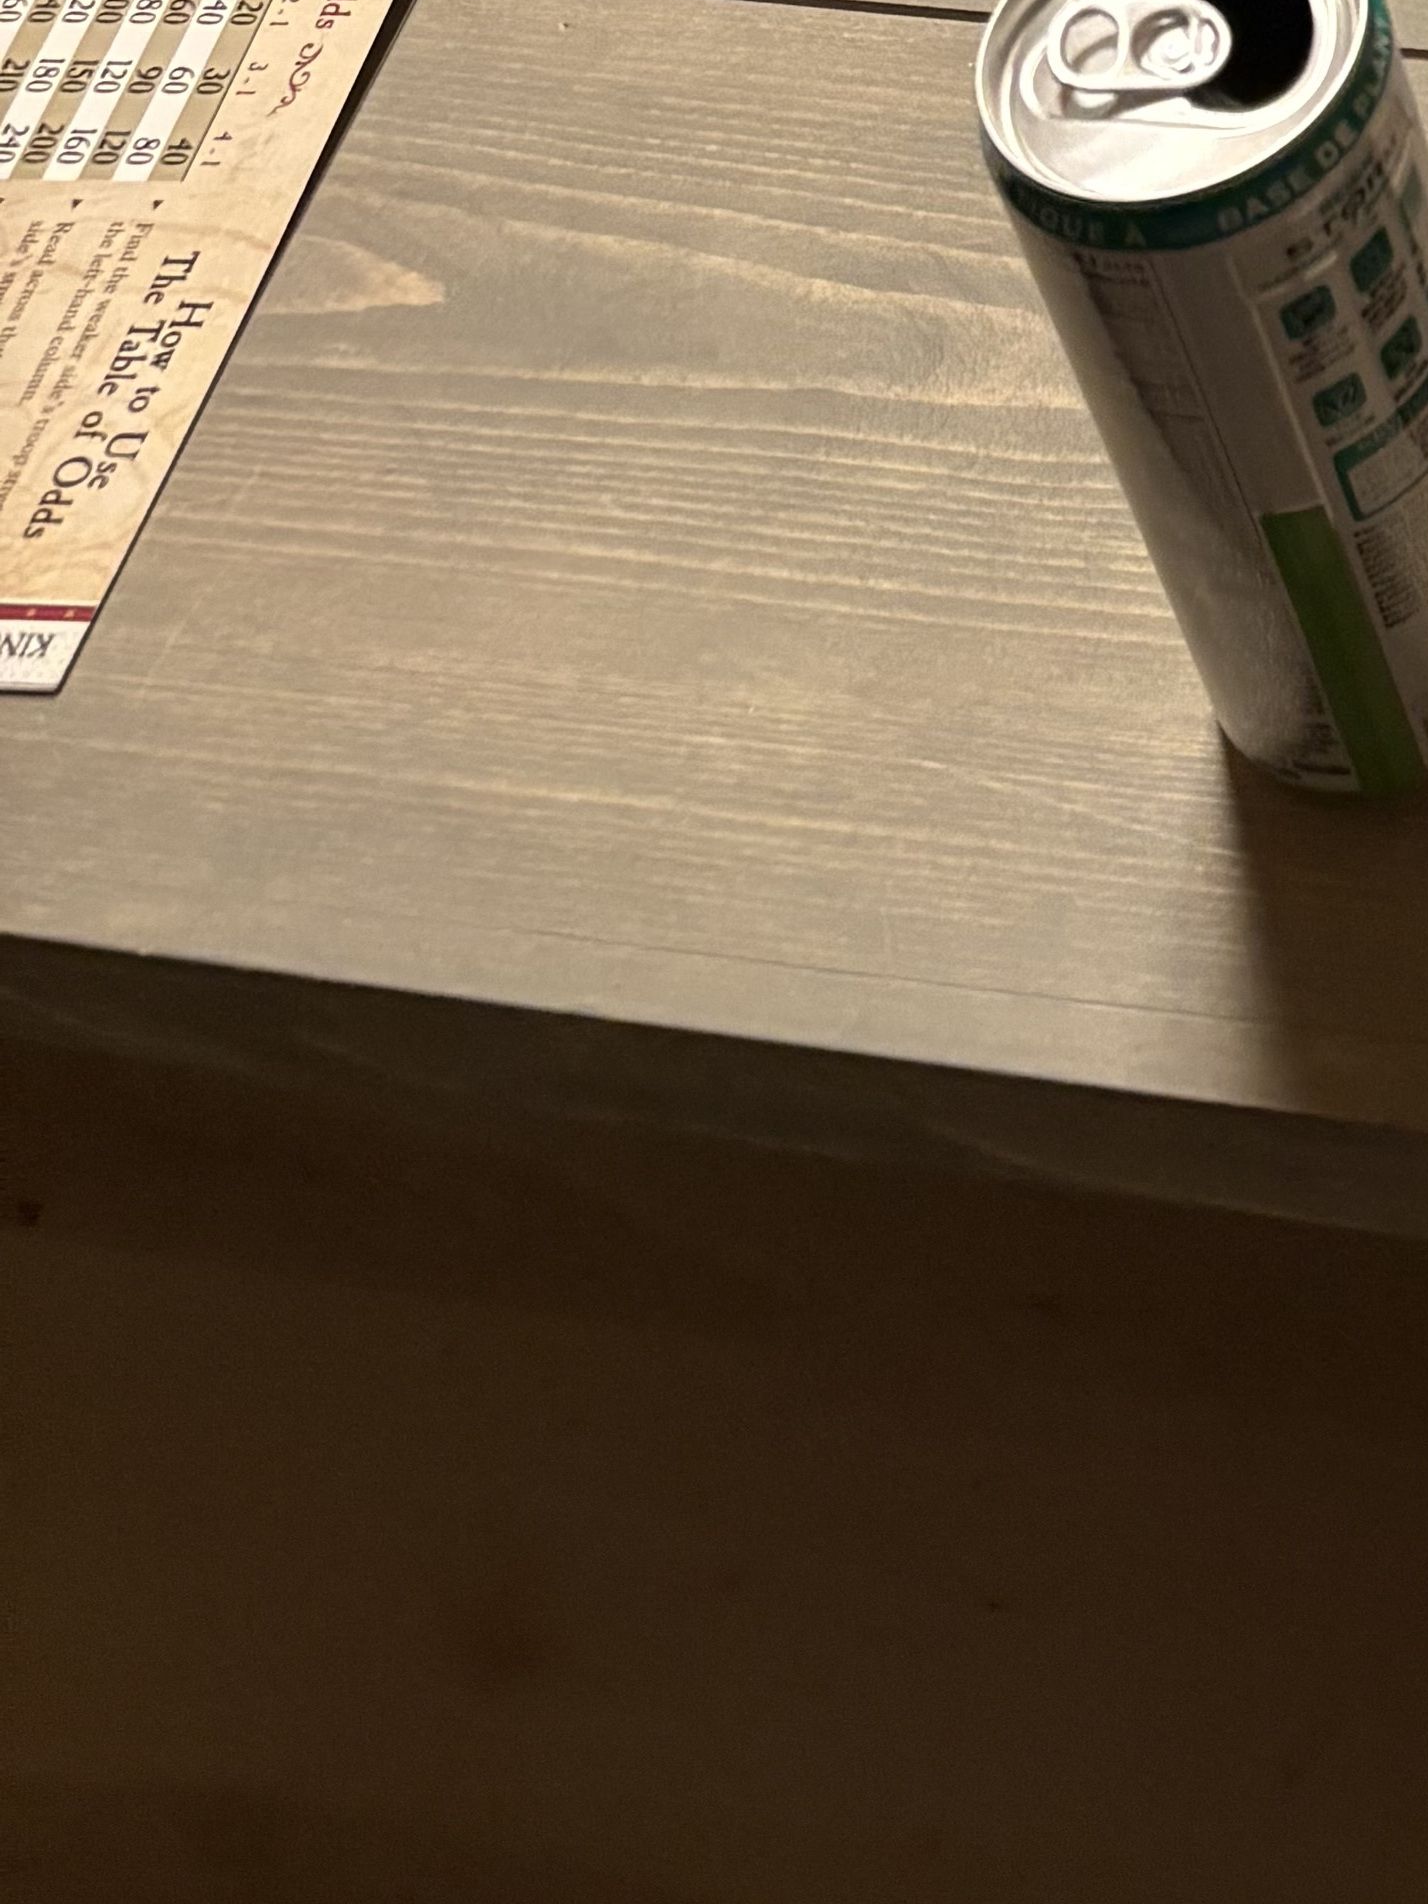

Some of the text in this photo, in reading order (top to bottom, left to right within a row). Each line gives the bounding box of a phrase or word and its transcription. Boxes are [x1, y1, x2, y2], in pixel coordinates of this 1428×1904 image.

[59, 58, 100, 93] 150
[93, 59, 134, 94] 120
[127, 65, 164, 94] 90
[161, 66, 196, 94] 60
[196, 66, 230, 95] 30
[22, 122, 64, 165] 200
[56, 128, 98, 165] 160
[91, 130, 132, 166] 120
[125, 137, 161, 166] 80
[161, 137, 195, 166] 40
[1218, 118, 1359, 231] BASE DE
[38, 221, 75, 265] Read
[99, 221, 124, 248] the
[119, 221, 154, 262] Find
[104, 267, 131, 294] the
[69, 299, 110, 361] weaker
[23, 249, 201, 540] The Table of Odds
[87, 299, 214, 490] How to Use
